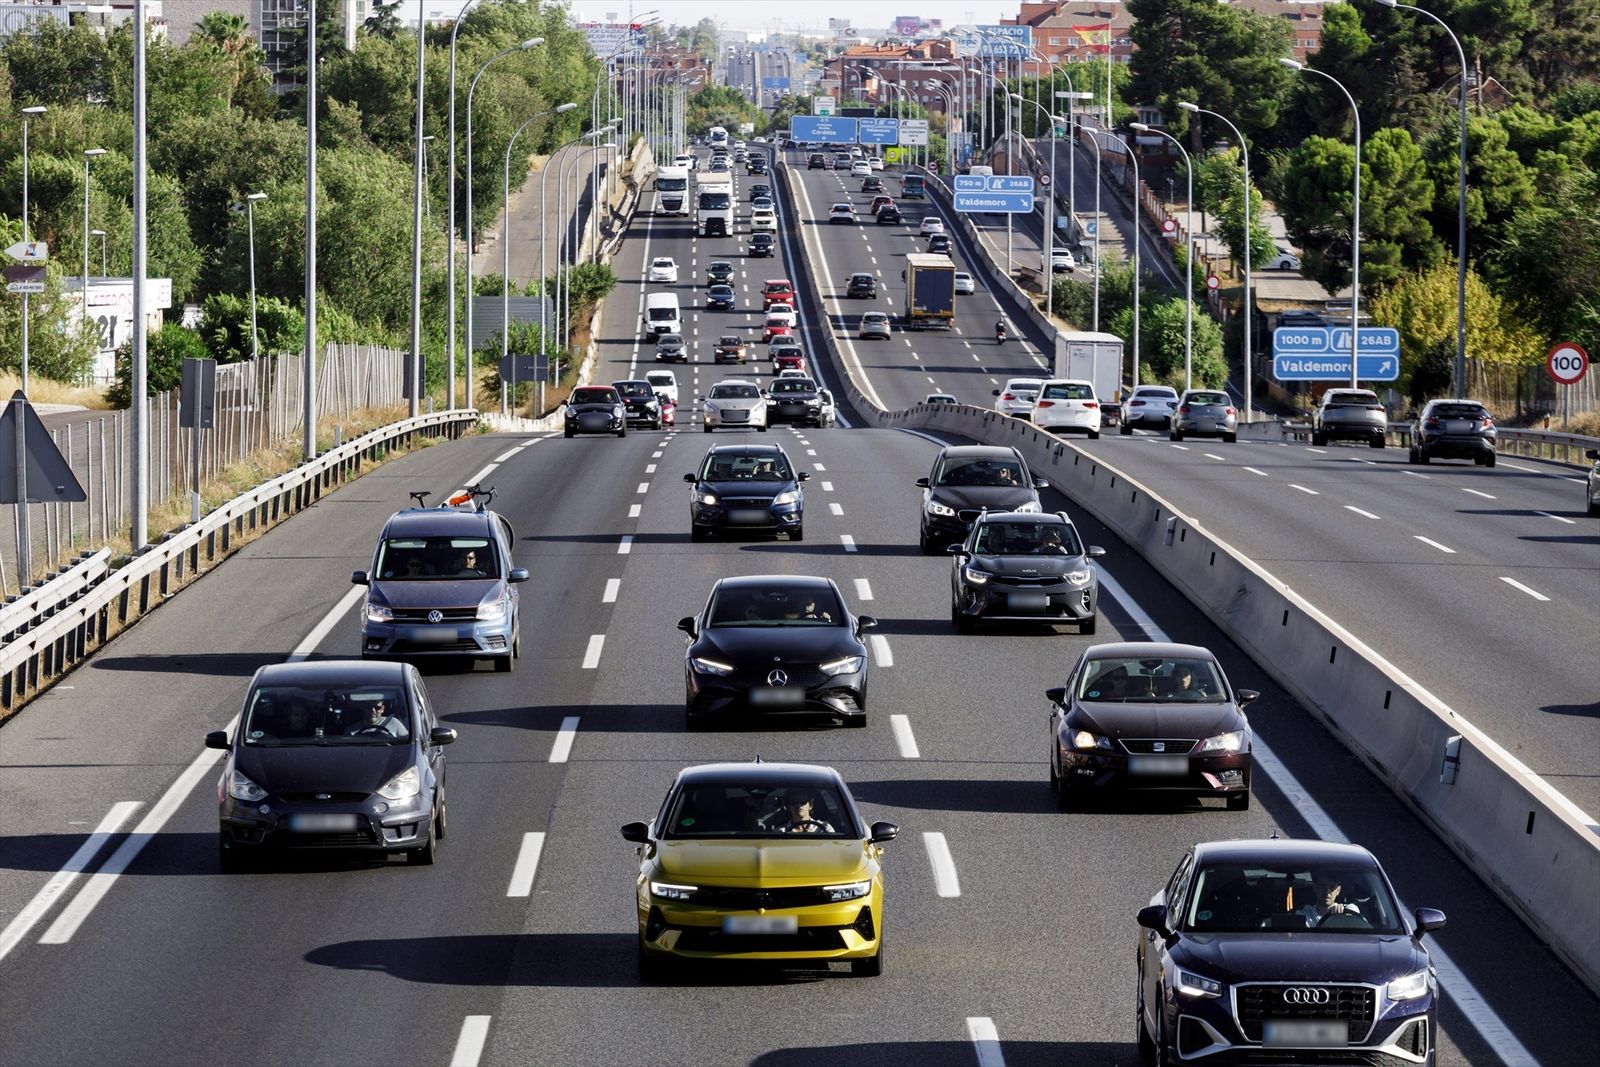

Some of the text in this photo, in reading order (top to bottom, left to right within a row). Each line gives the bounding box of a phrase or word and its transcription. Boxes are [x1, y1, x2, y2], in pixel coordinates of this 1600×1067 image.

[959, 198, 1007, 206] Valdemoro
[1281, 335, 1322, 345] 1000 m
[1361, 335, 1392, 345] 26AB
[1553, 356, 1582, 370] 100
